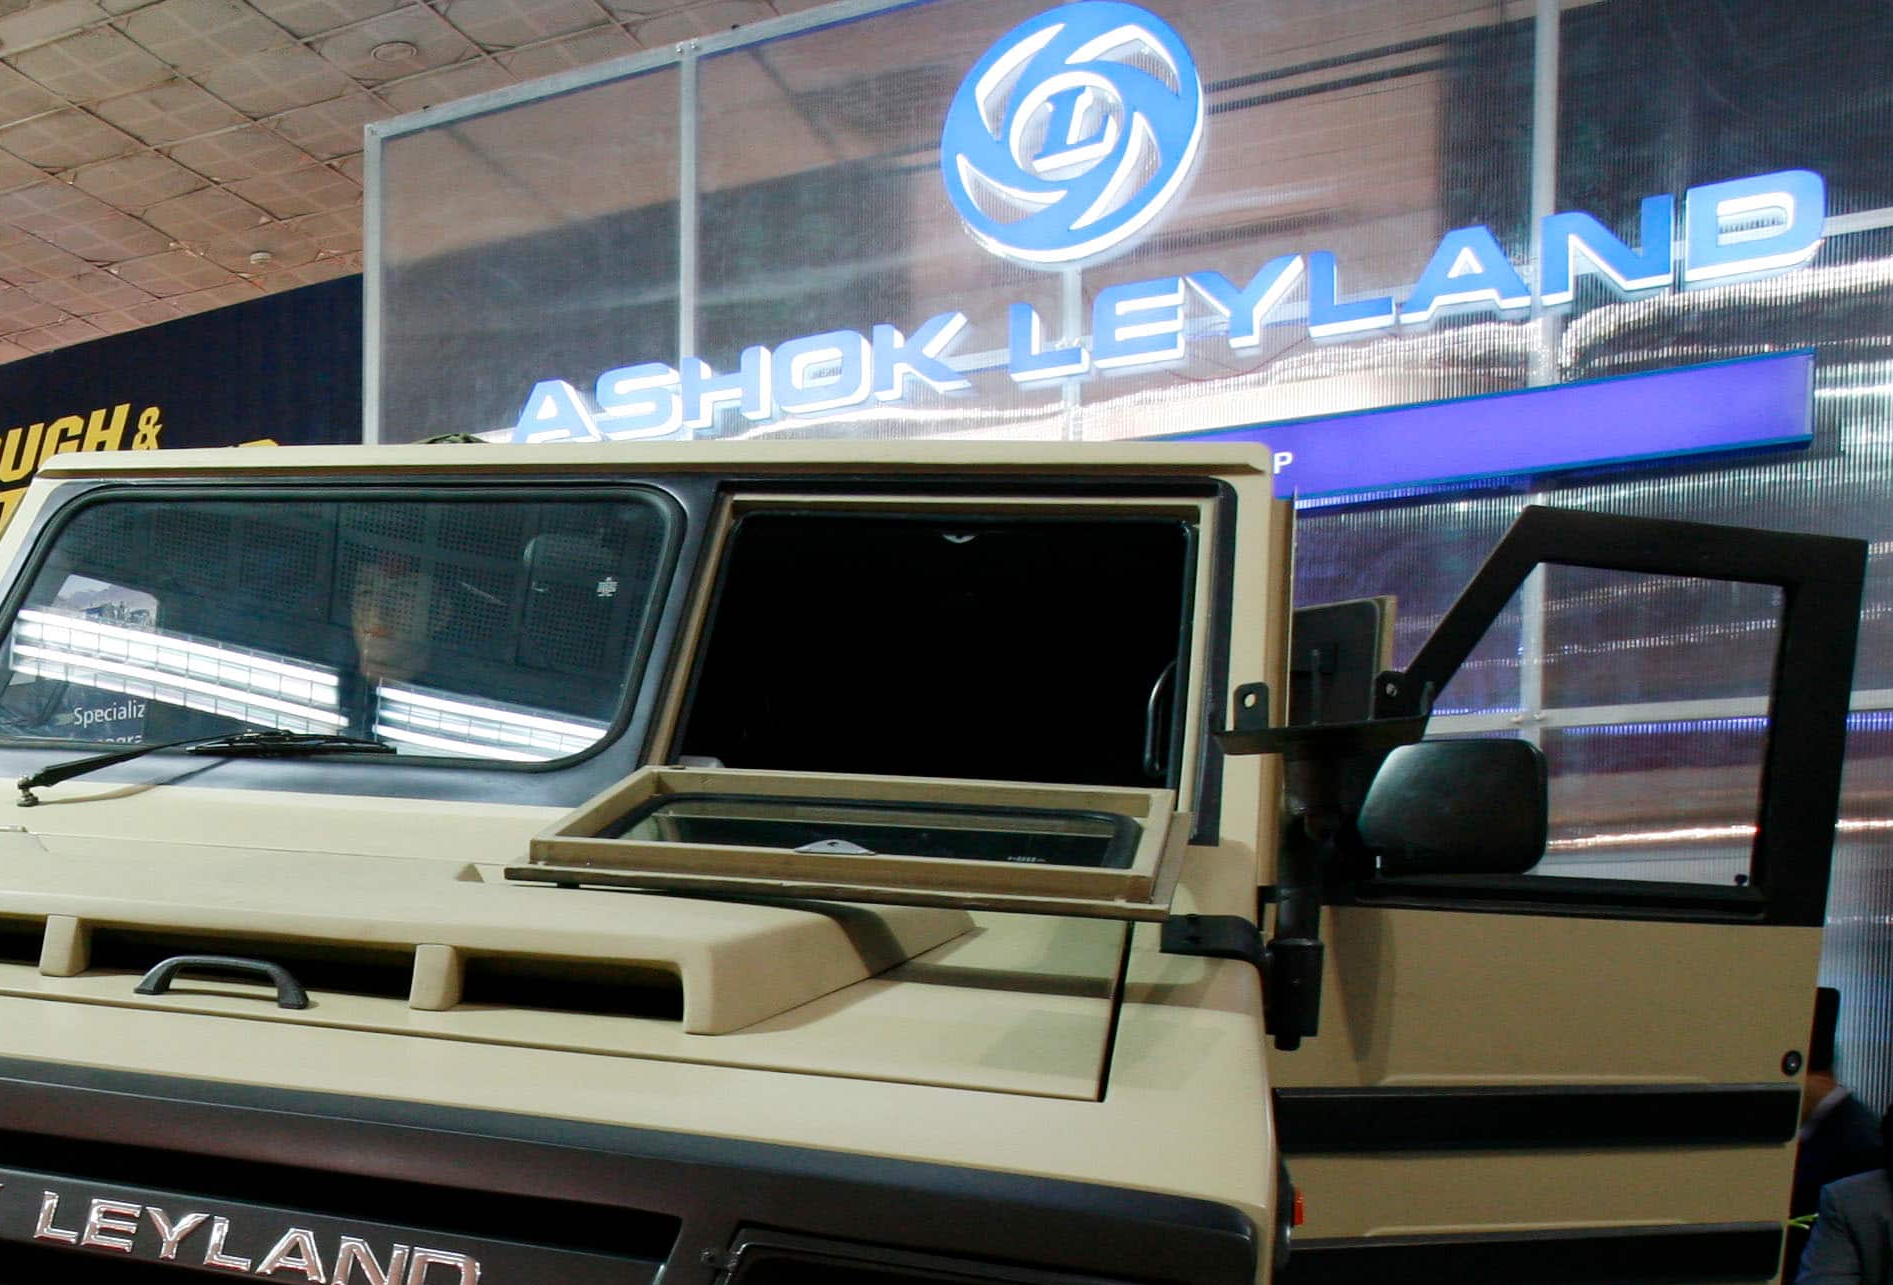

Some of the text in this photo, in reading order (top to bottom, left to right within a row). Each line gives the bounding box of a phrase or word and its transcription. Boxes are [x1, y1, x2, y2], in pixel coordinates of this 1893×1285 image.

[511, 169, 1827, 443] ASHOK LEYLAND
[73, 700, 145, 729] Specializ
